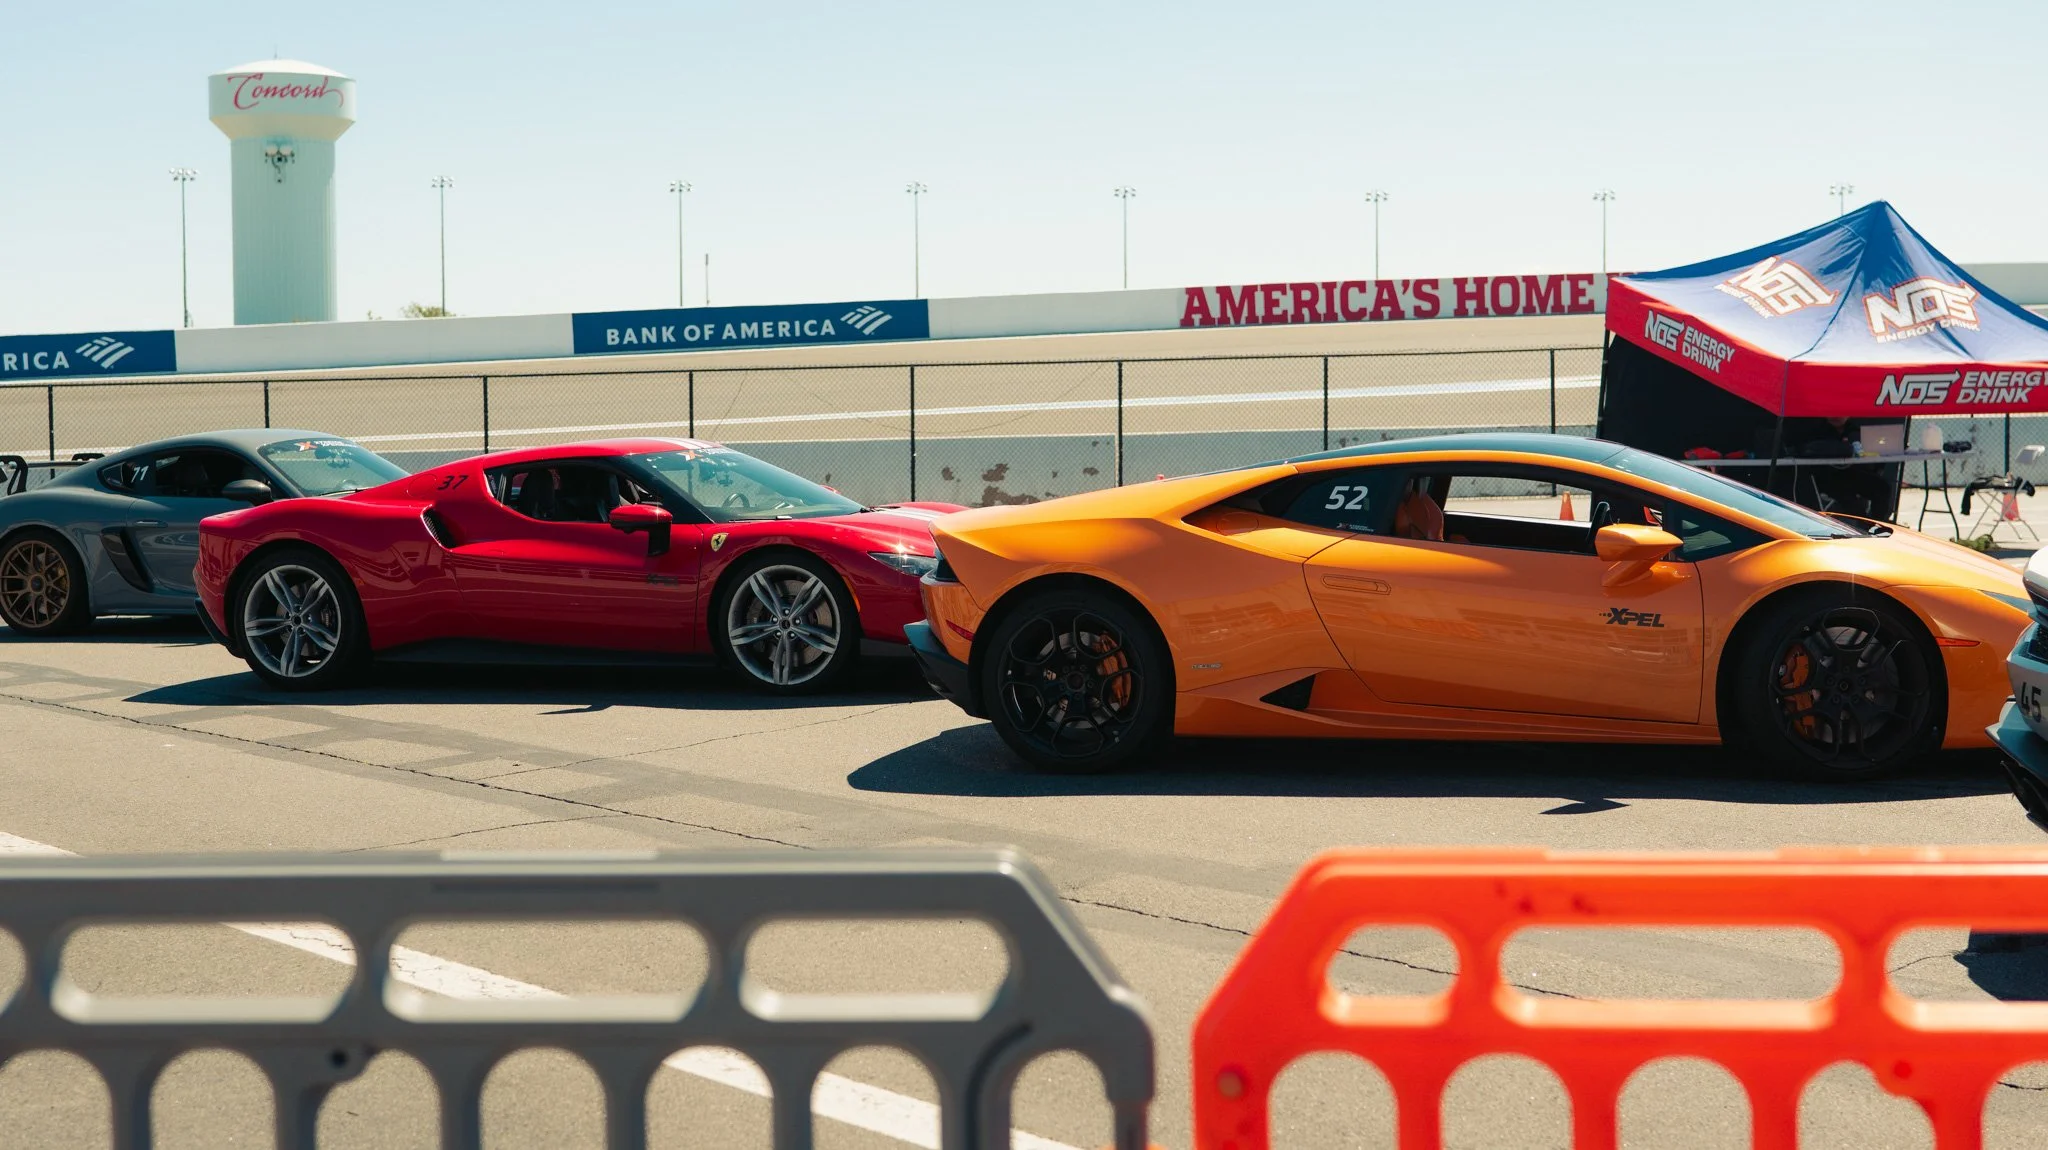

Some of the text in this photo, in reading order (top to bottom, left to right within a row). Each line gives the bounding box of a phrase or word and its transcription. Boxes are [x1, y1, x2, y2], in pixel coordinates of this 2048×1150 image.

[226, 72, 344, 110] Concord
[1179, 273, 1595, 328] AMERICA'S HOME
[1862, 276, 1981, 336] NOS
[606, 319, 836, 345] BANK OF AMERICA
[1644, 309, 1685, 352] NOS
[1684, 325, 1735, 363] ENERGY
[1876, 318, 1980, 344] ENERGY DRINK
[1682, 340, 1721, 374] DRINK
[1875, 370, 1961, 405] NOS
[1956, 388, 2033, 405] DRINK
[437, 474, 469, 491] 37
[1324, 485, 1369, 510] 52
[1605, 607, 1665, 628] XPEL
[2020, 681, 2042, 723] 45
